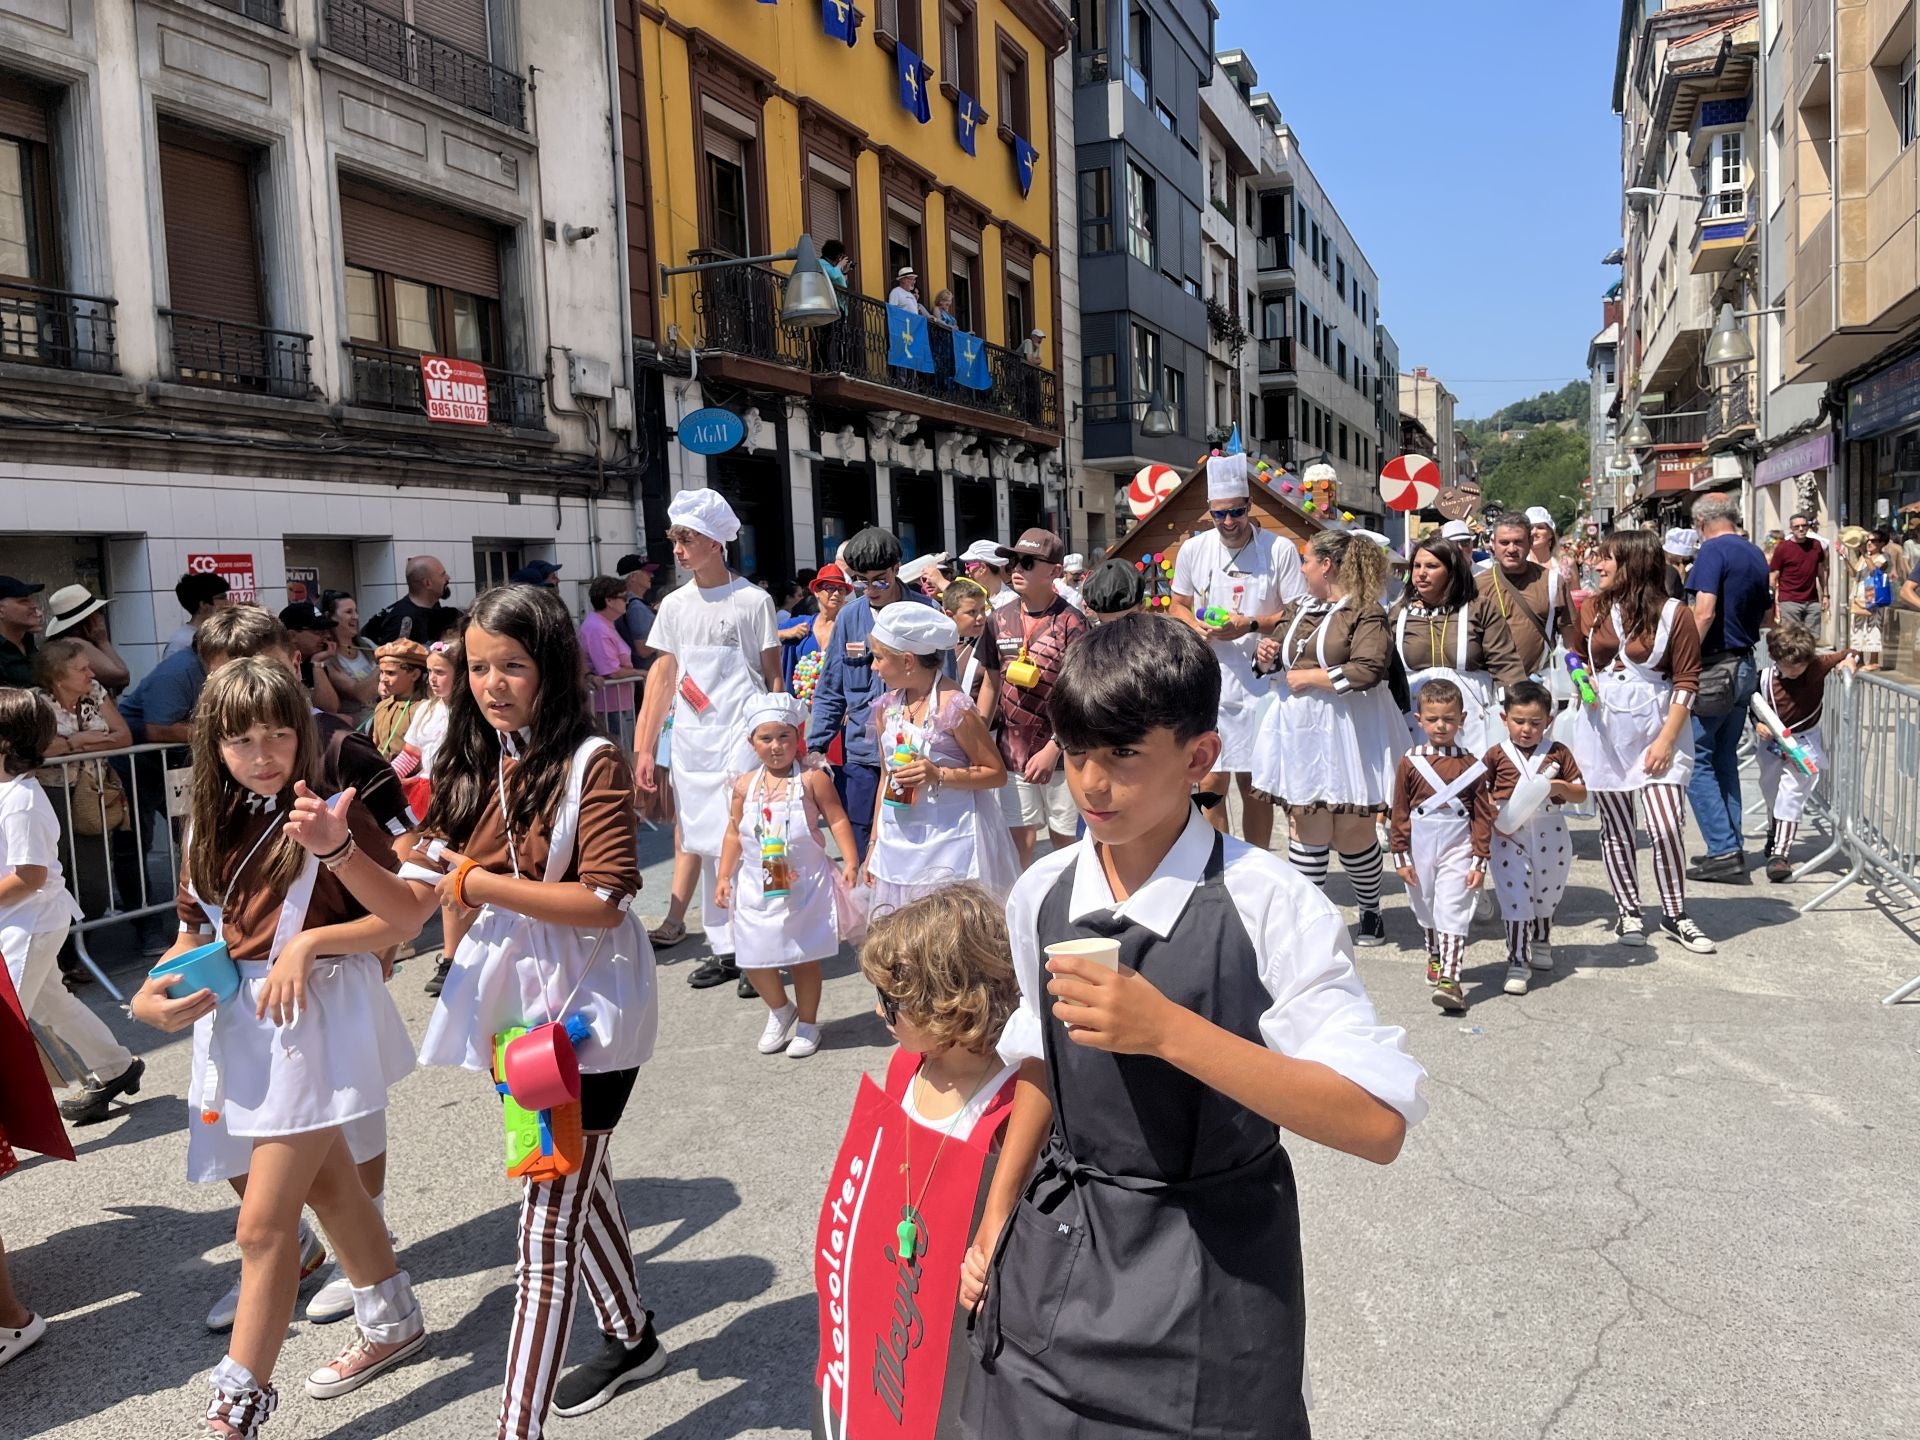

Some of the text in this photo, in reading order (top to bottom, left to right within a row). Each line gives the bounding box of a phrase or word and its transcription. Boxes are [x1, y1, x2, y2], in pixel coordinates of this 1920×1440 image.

[426, 378, 487, 405] VENDE
[431, 402, 486, 421] 985 61 03 27
[693, 423, 728, 444] AGM
